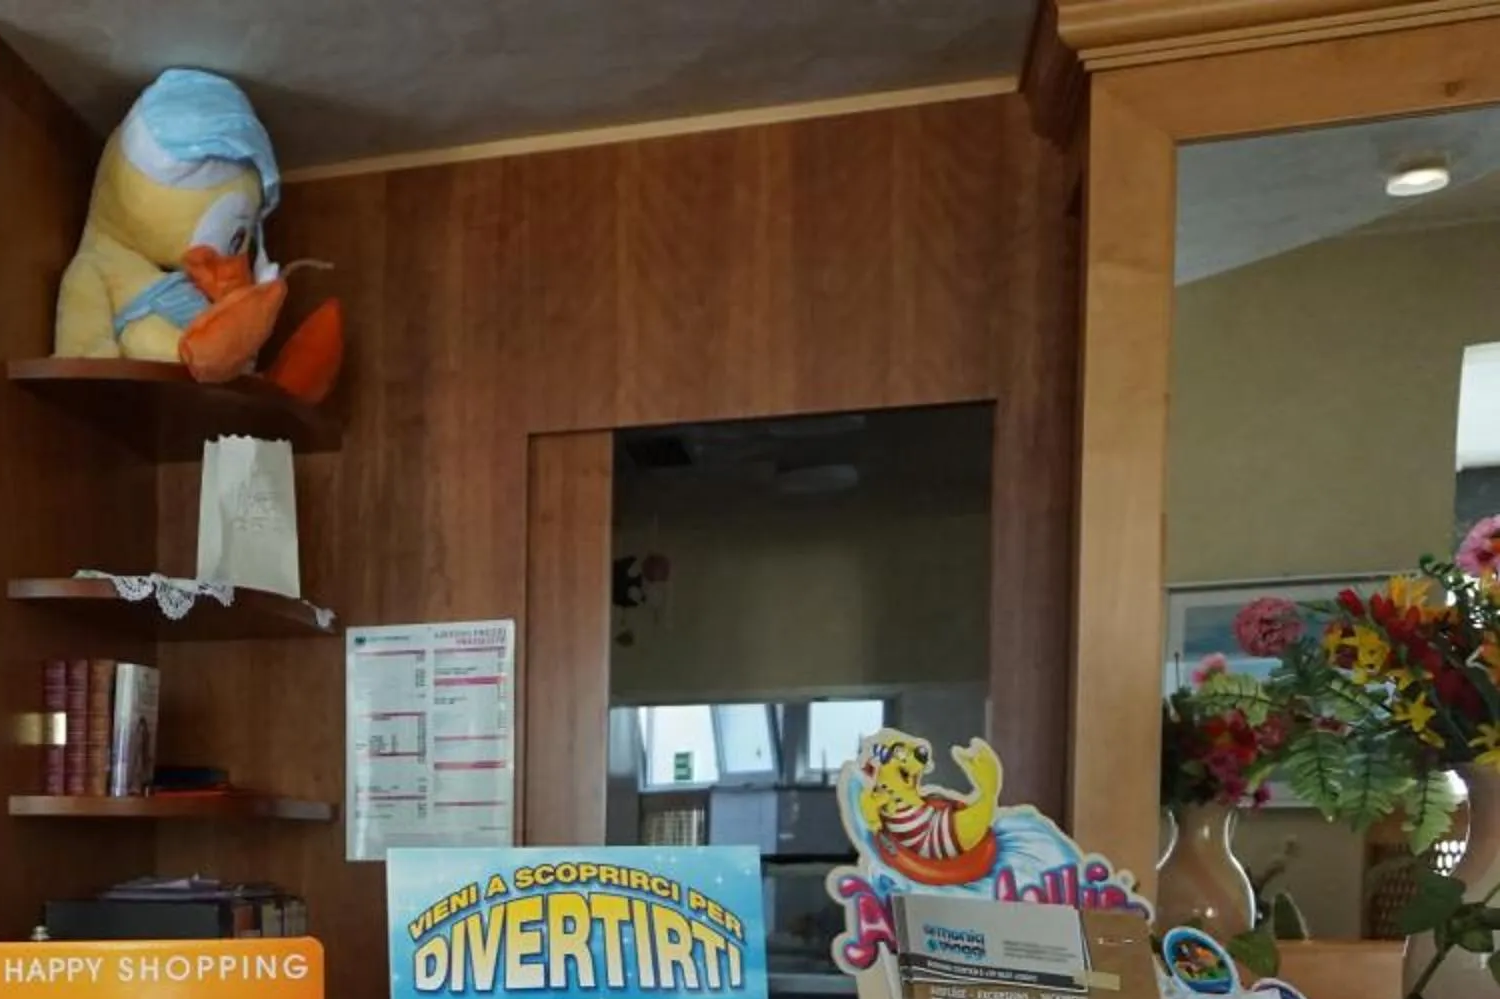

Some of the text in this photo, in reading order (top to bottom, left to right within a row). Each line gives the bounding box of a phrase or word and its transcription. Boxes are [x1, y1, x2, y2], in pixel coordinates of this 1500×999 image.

[408, 862, 746, 940] VIENI A SCOPRIRCI PER
[4, 956, 105, 984] HAPPY
[118, 953, 311, 982] SHOPPING
[411, 892, 745, 994] DIVERTIRTI
